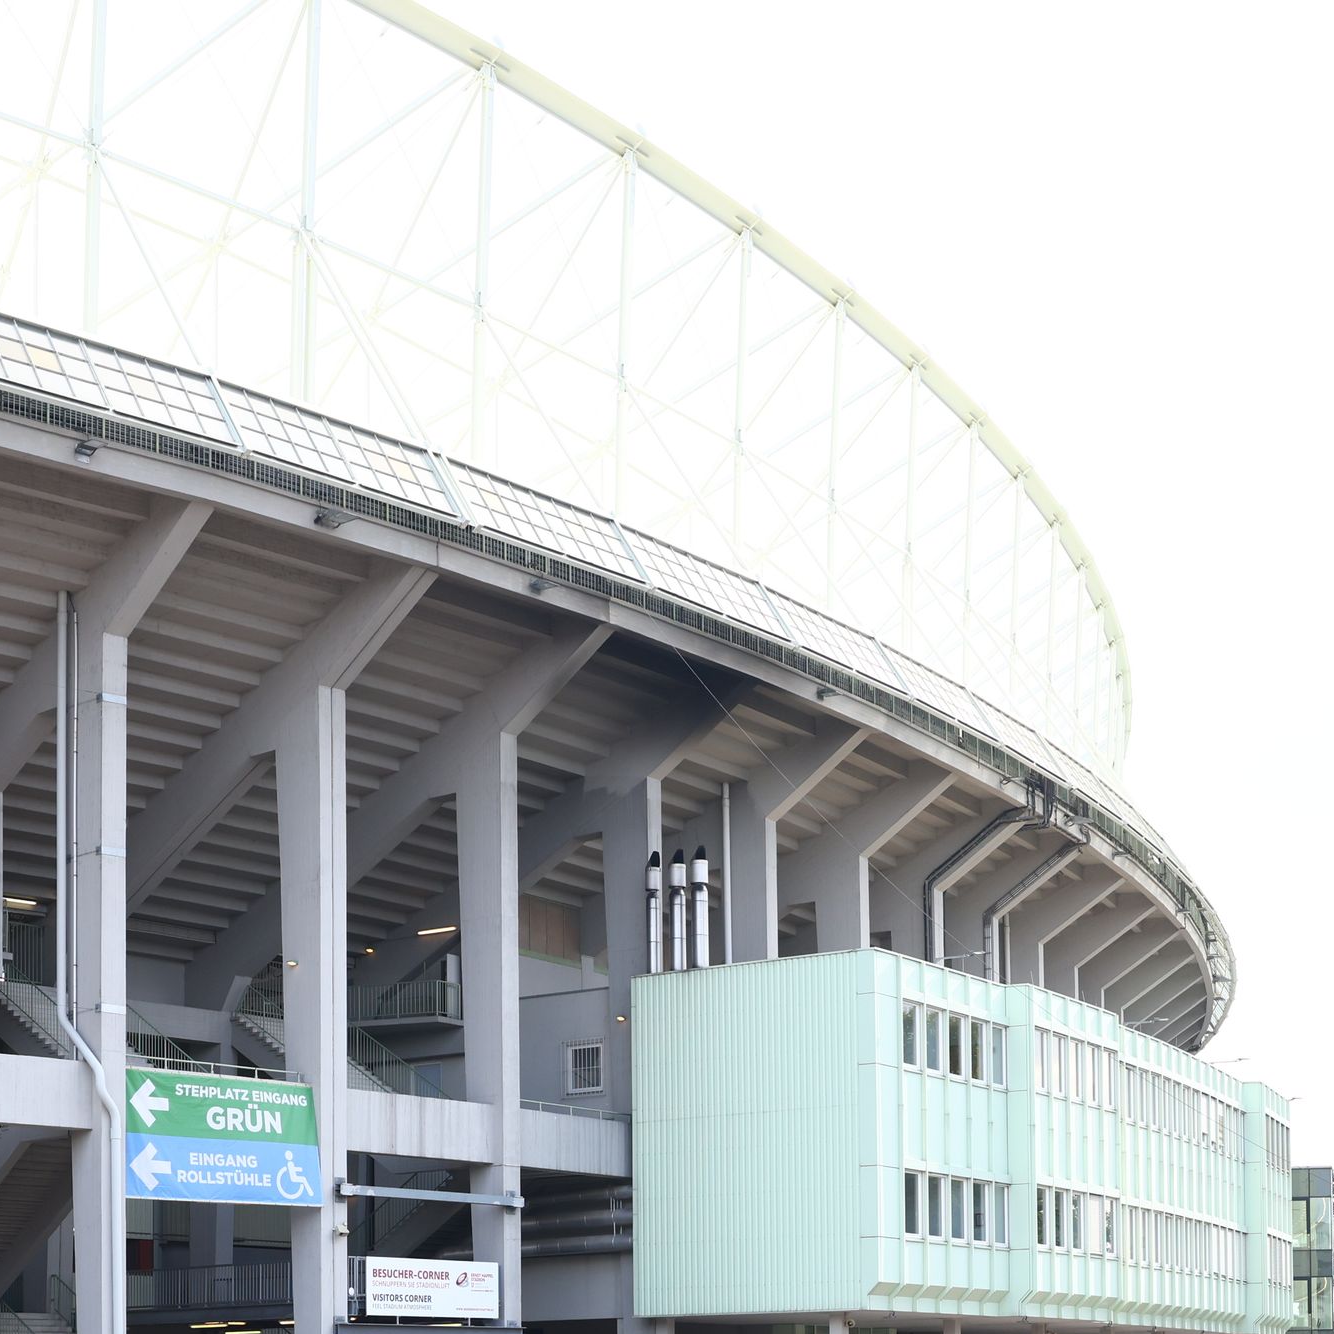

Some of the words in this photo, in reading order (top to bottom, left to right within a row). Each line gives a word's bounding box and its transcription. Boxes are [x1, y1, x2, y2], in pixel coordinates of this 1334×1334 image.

[175, 1083, 249, 1101] STEHPLATZ
[252, 1090, 308, 1107] EINGANG
[206, 1103, 282, 1134] GRÜN
[189, 1152, 258, 1168] EINGANG
[177, 1170, 272, 1187] ROLLSTÜHLE
[372, 1268, 450, 1280] BESUCHER-CORNER
[372, 1293, 404, 1302] VISITORS
[404, 1294, 432, 1303] CORNER
